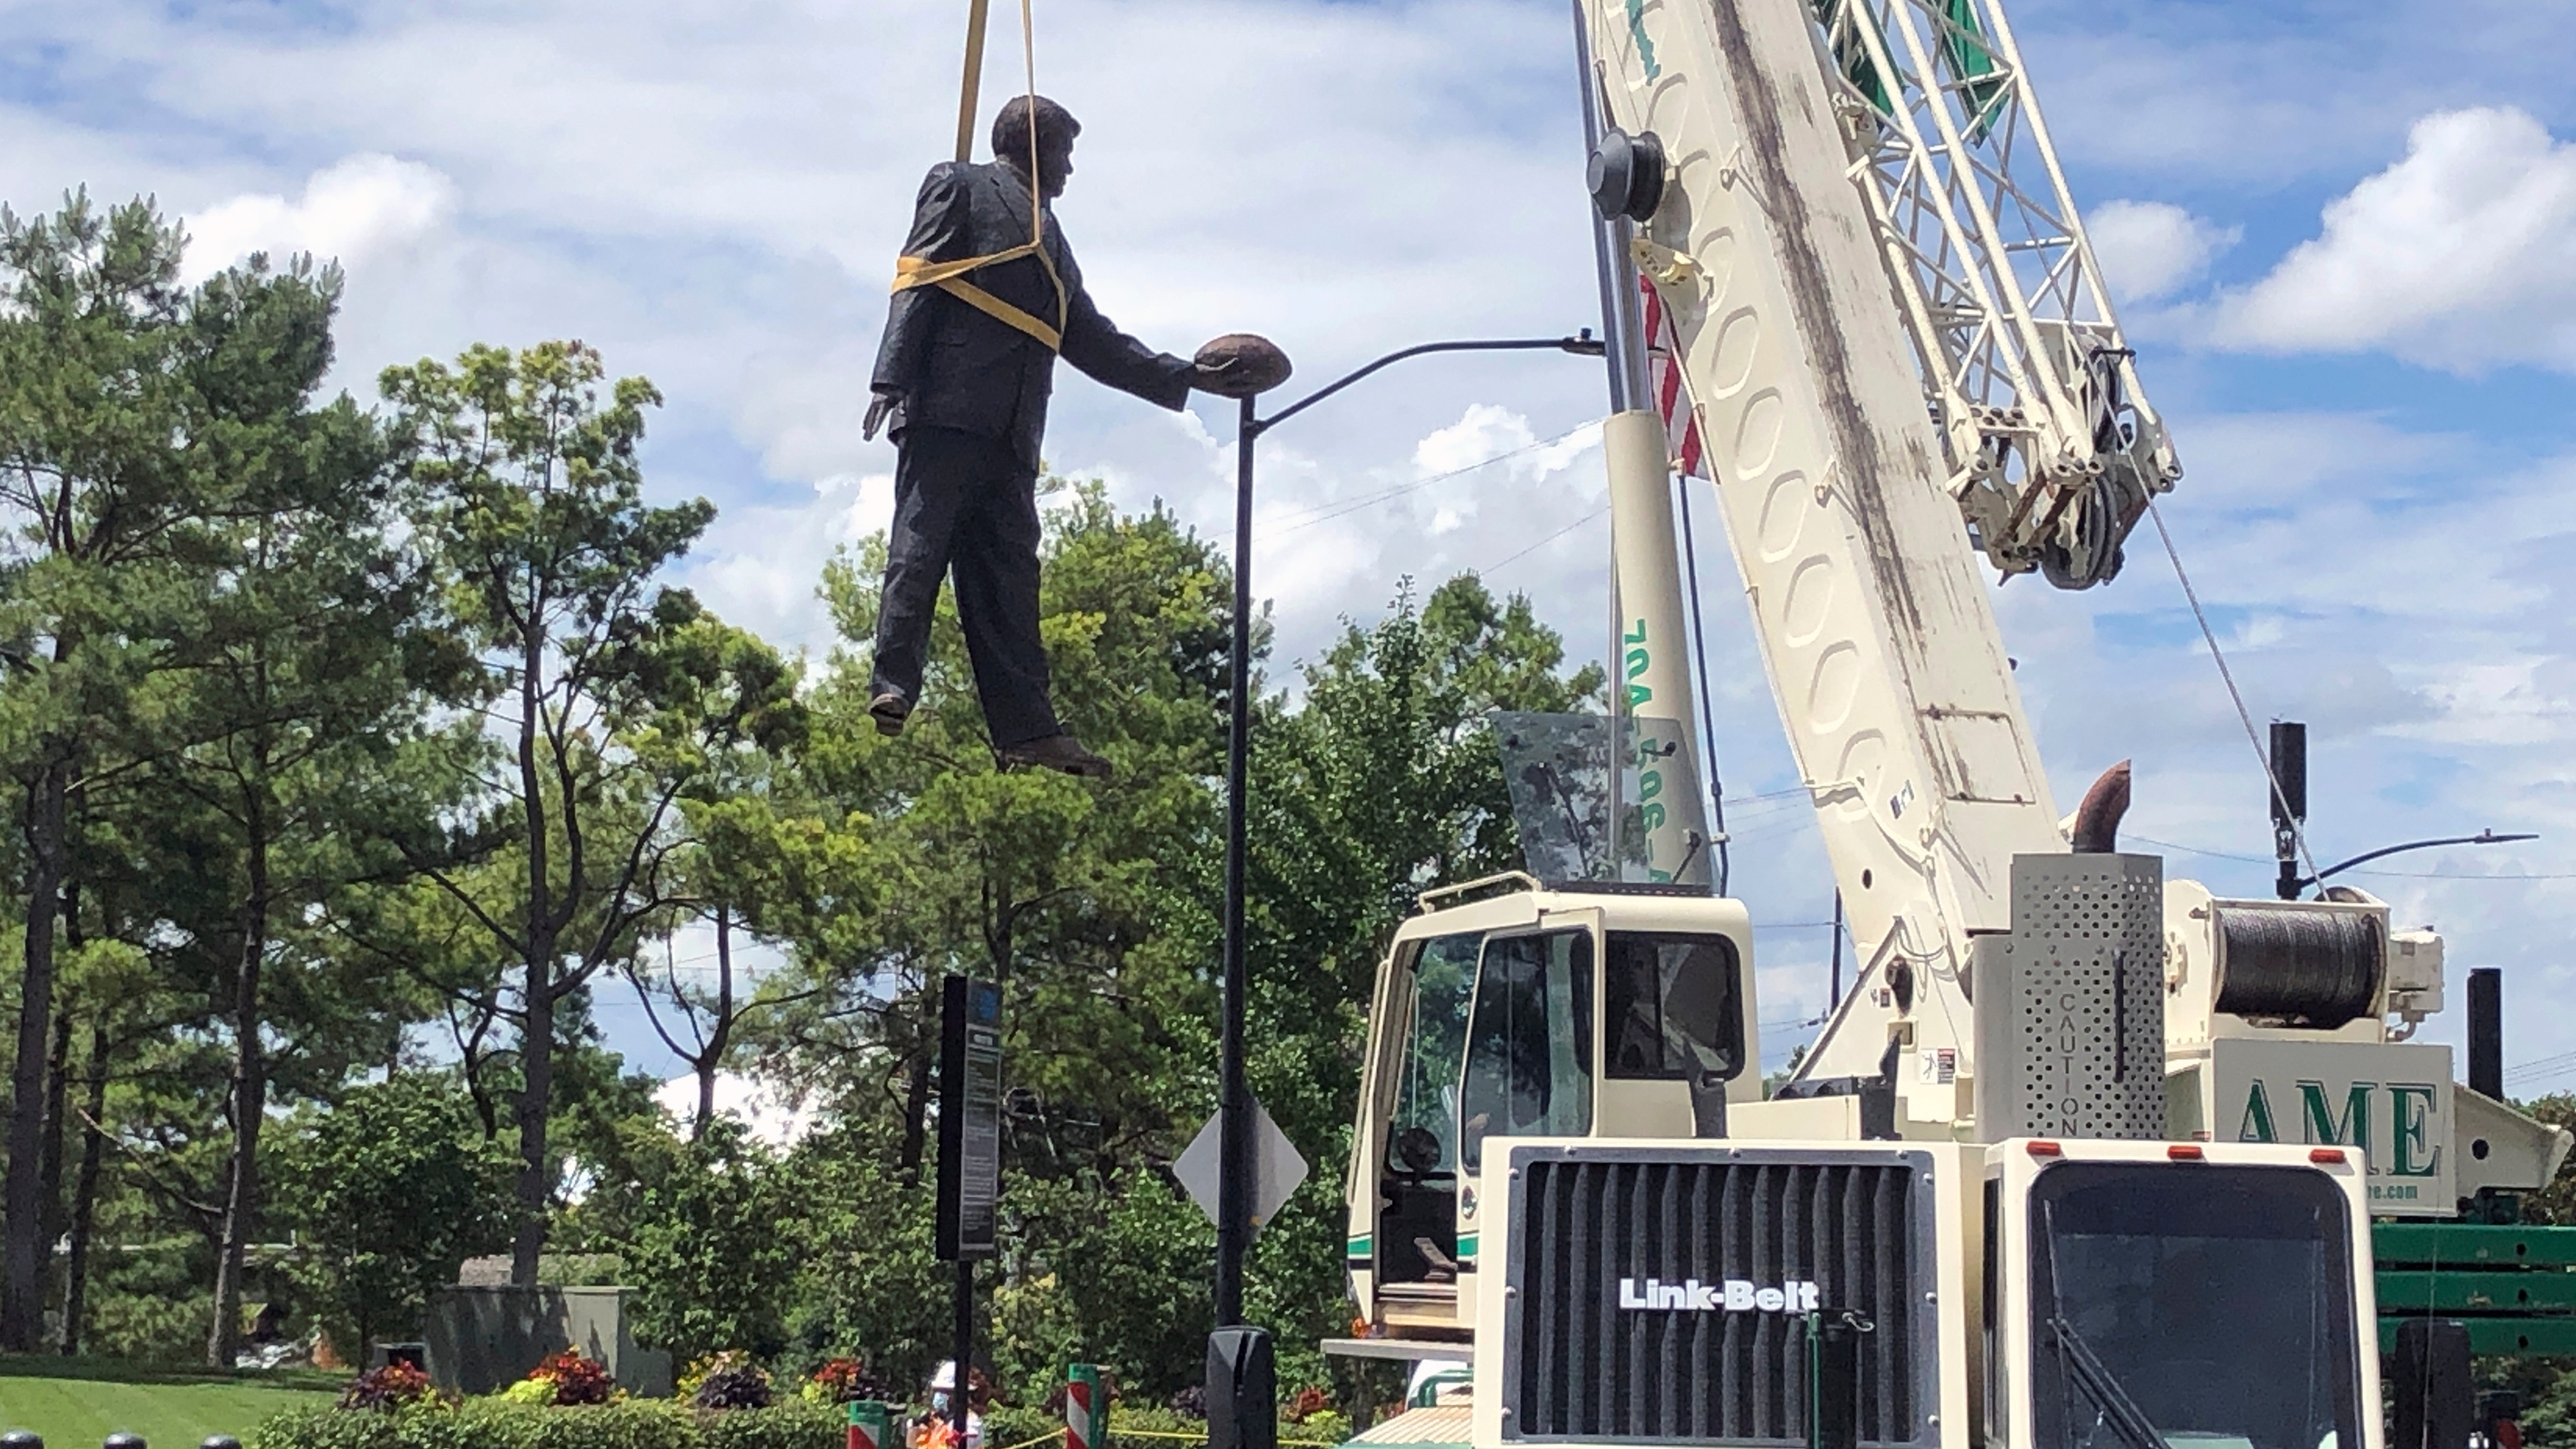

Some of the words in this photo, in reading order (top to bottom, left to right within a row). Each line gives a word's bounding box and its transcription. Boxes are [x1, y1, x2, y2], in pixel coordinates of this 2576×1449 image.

[2059, 993, 2079, 1137] CAUTION
[2238, 1078, 2441, 1177] AME
[1619, 1278, 1820, 1311] Link-Belt
